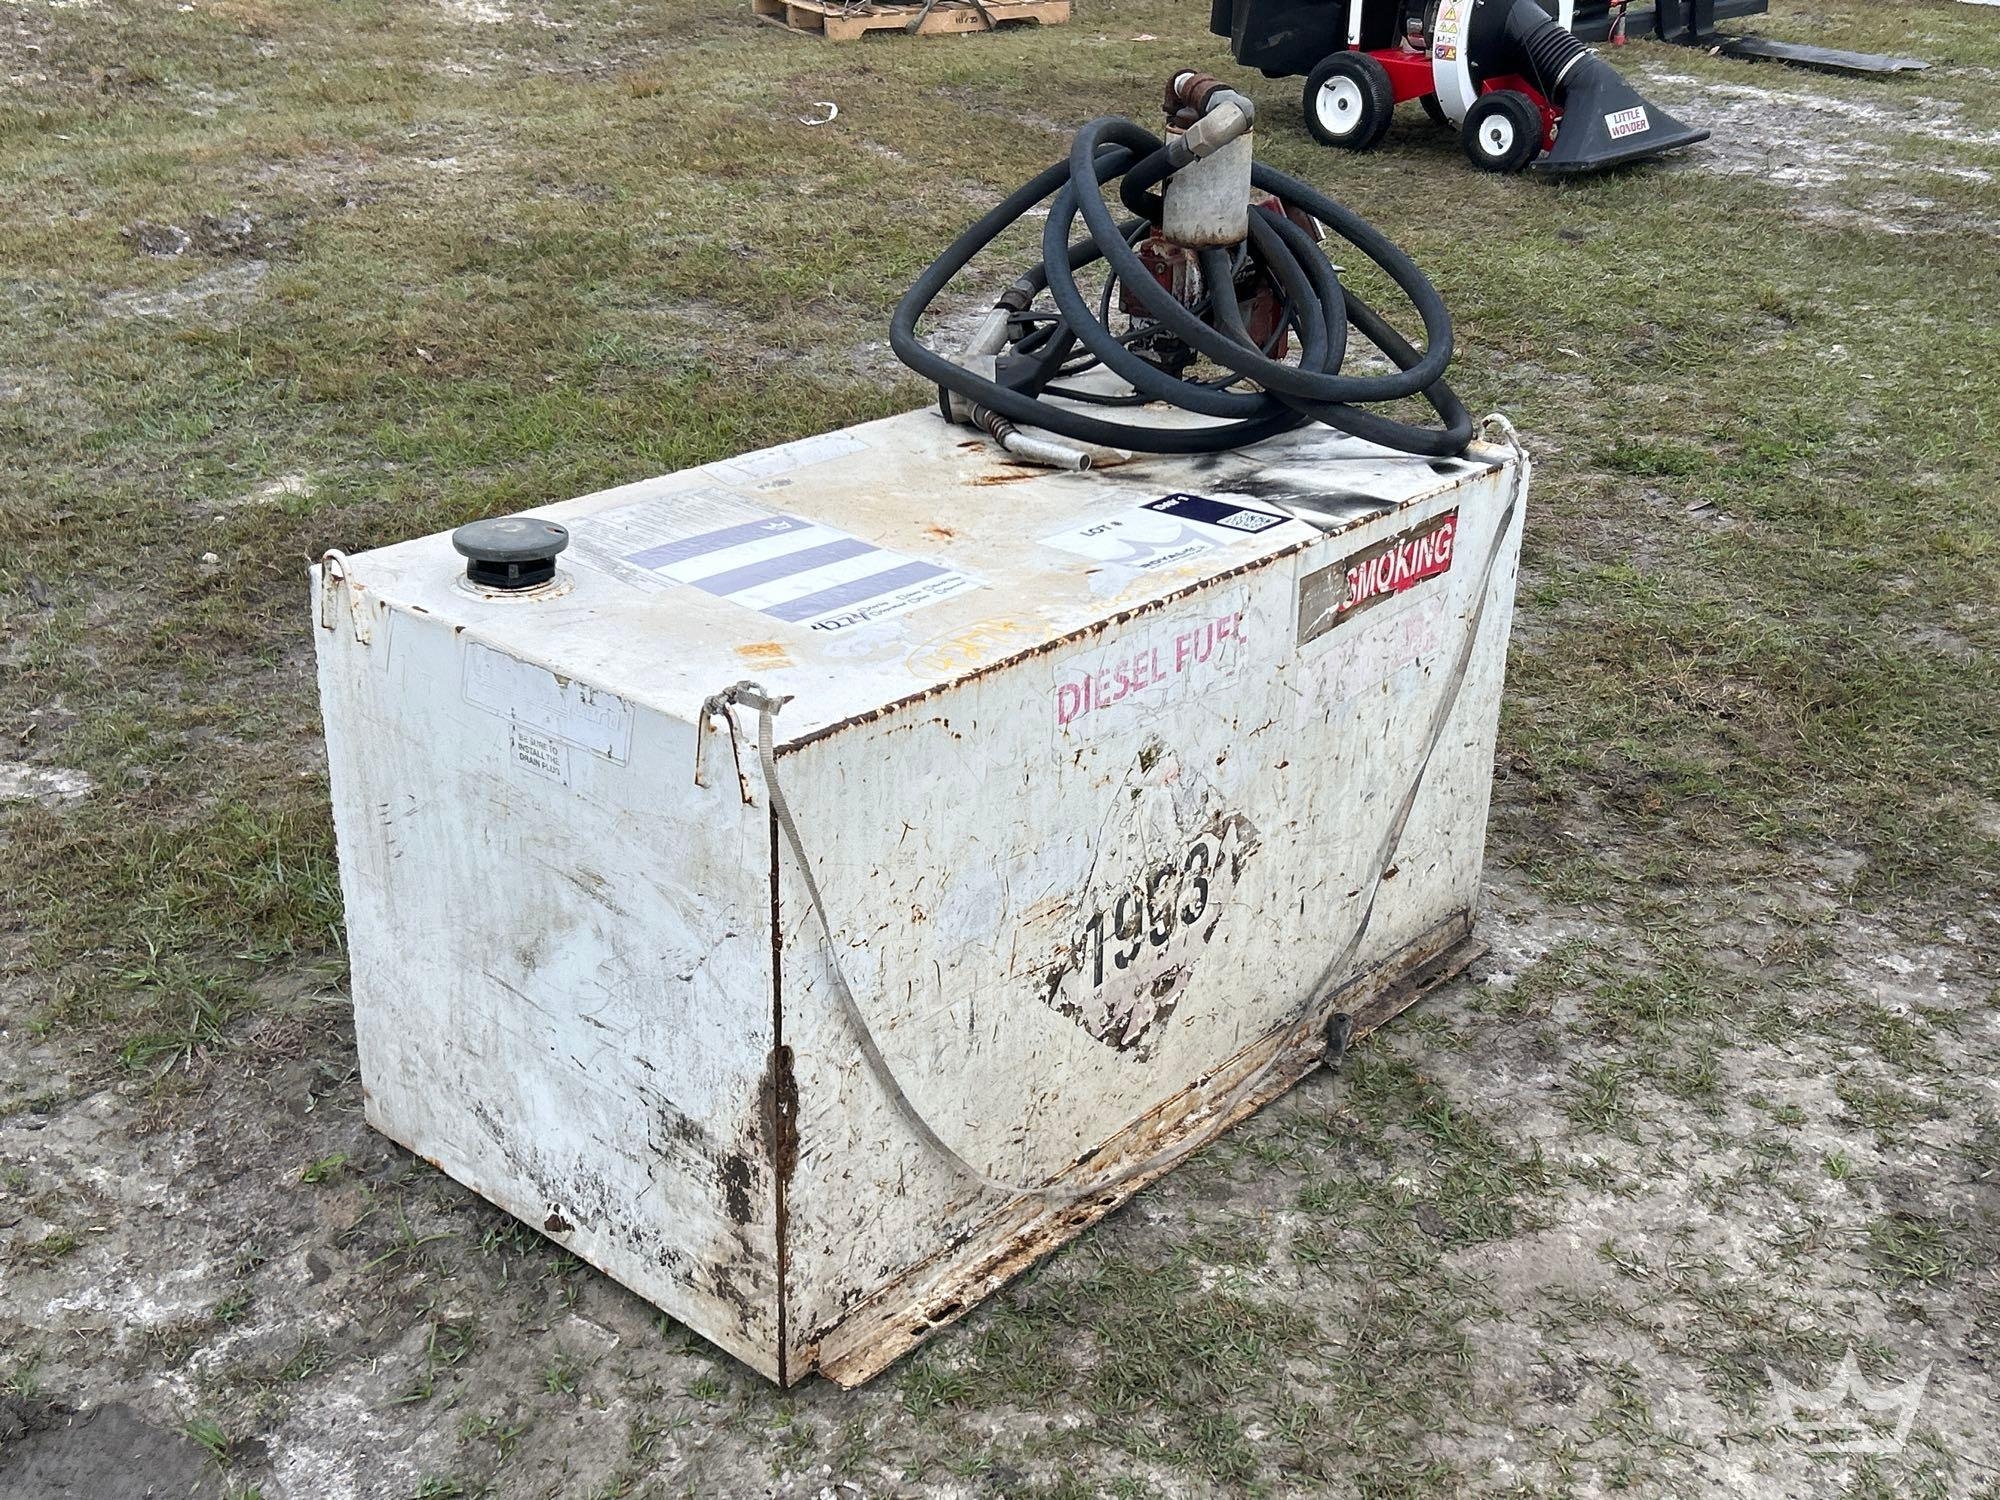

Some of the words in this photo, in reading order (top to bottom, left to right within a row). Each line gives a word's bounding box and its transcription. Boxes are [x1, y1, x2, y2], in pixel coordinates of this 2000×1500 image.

[1611, 119, 1647, 137] WONDER
[1613, 109, 1640, 124] LITTLE
[1079, 524, 1112, 537] LOT
[1338, 522, 1454, 611] SMOKING
[1057, 646, 1167, 726] DIESEL
[517, 742, 546, 761] INSTALL
[545, 753, 561, 767] THE
[518, 732, 529, 743] BE
[530, 736, 548, 751] SURE
[548, 744, 558, 756] TO
[518, 752, 541, 768] DRAIN
[541, 761, 561, 776] PLUG
